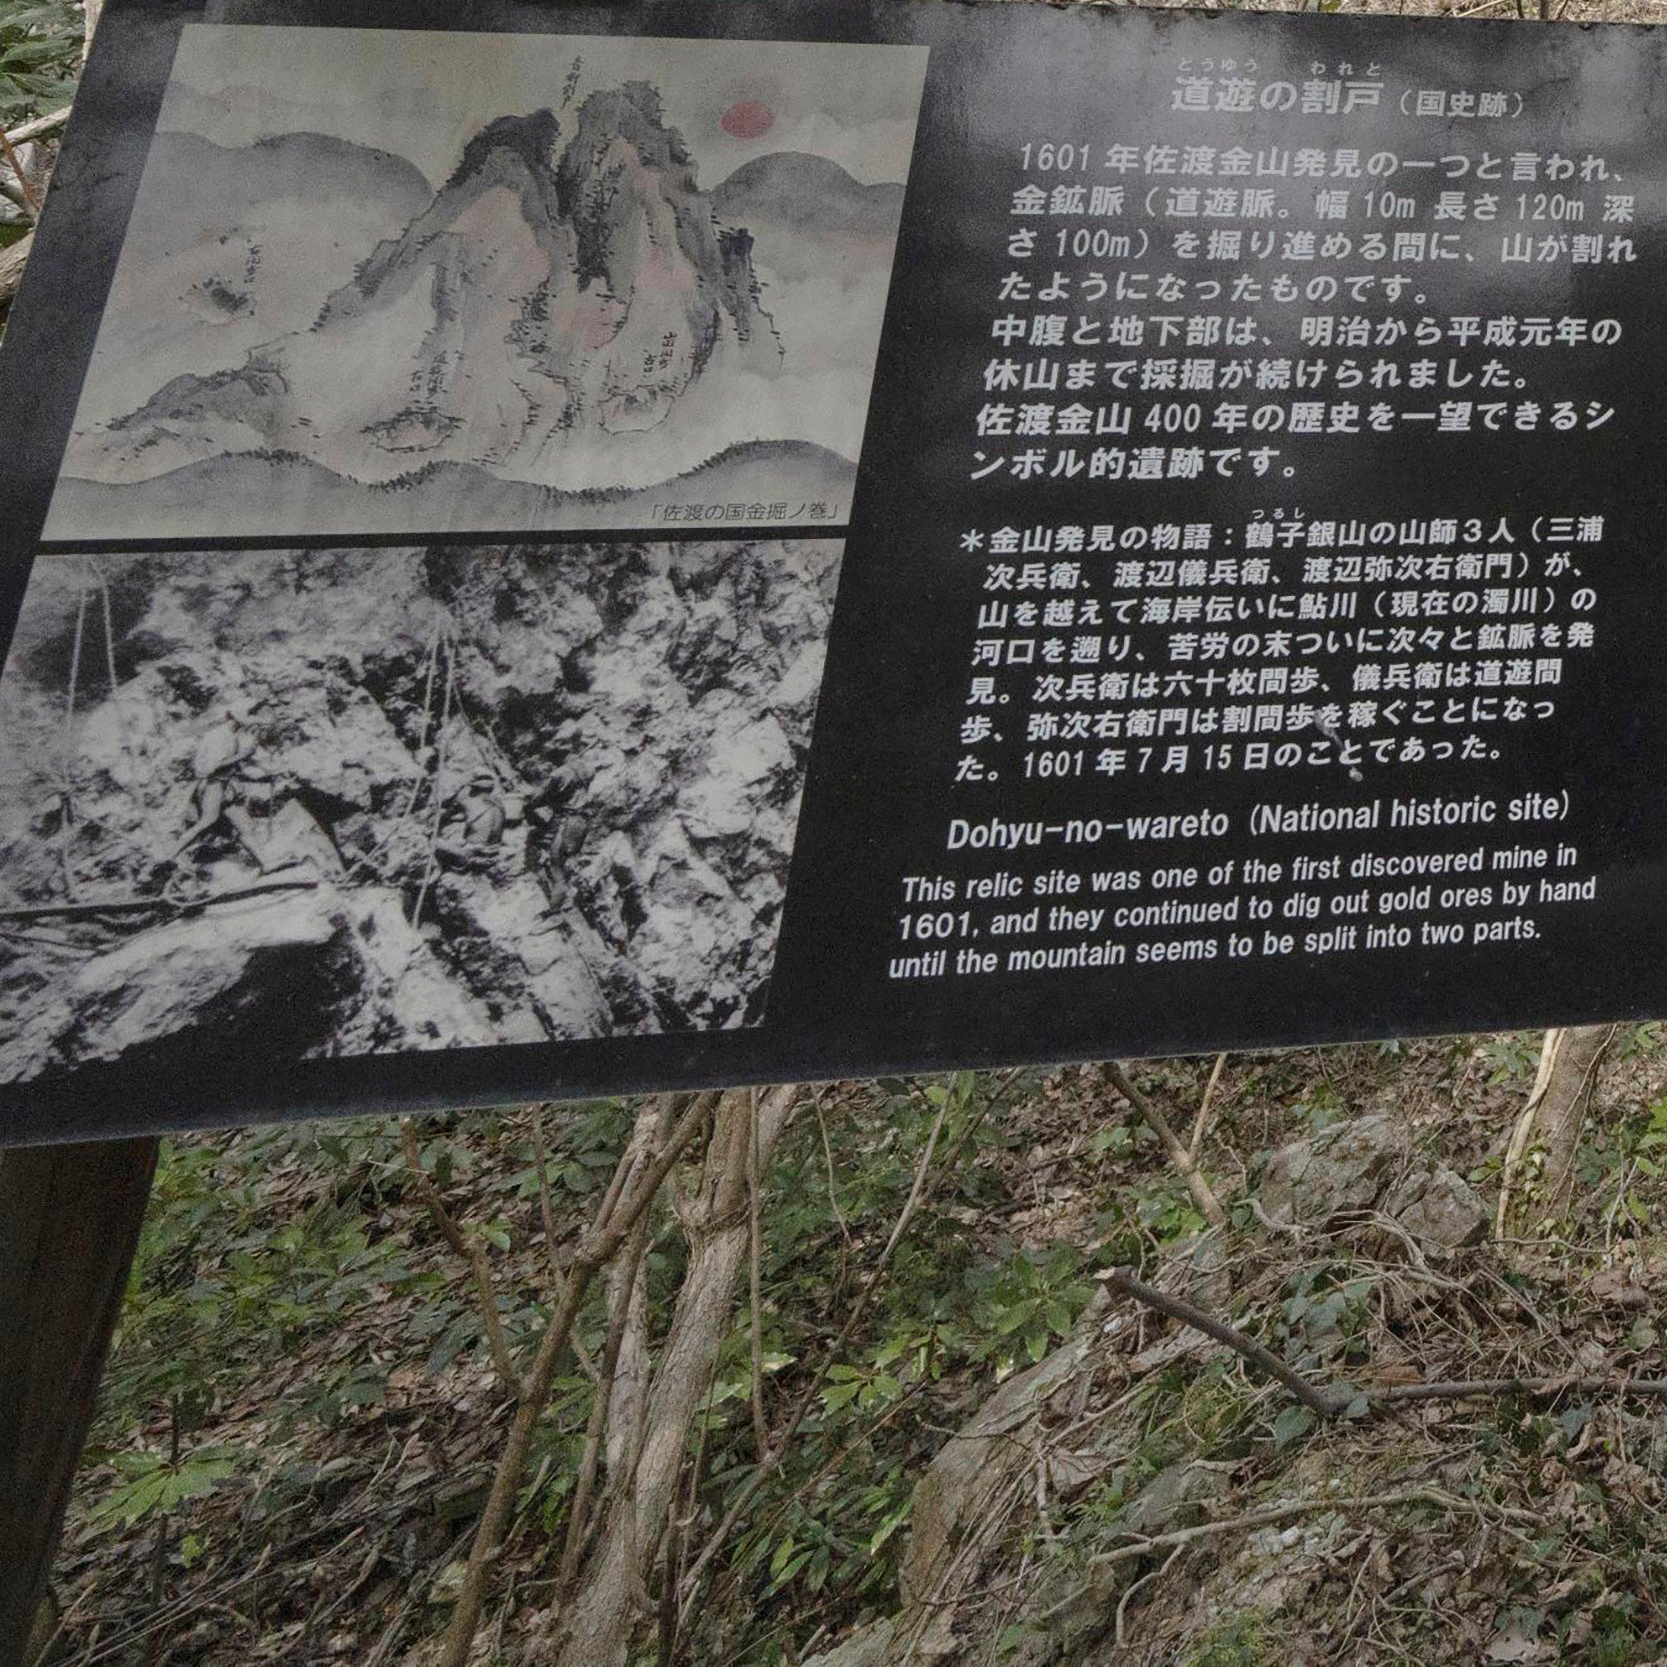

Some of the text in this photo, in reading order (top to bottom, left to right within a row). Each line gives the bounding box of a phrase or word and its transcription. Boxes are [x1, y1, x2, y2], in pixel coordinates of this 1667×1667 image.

[1311, 60, 1380, 76] われと
[998, 270, 1428, 305] たようになったものです。
[983, 358, 1527, 392] 休山まで採掘が続けられました。
[970, 446, 1297, 481] ンボル的遺跡です。
[1252, 507, 1307, 520] つるし
[1250, 799, 1380, 835] (National
[1391, 795, 1496, 827] historic
[1508, 789, 1569, 821] site)
[903, 842, 1577, 902] This relic site was one of the first discovered mine in
[990, 907, 1039, 934] and
[1048, 905, 1105, 932] they
[1114, 896, 1239, 928] continued
[1248, 895, 1273, 920] to
[1283, 892, 1321, 919] dig
[1330, 889, 1370, 914] out
[1379, 885, 1431, 913] gold
[1440, 885, 1493, 908] ores
[1502, 880, 1531, 907] by
[1539, 876, 1597, 904] hand
[889, 915, 1542, 978] until the mountain seems to be split into two parts.
